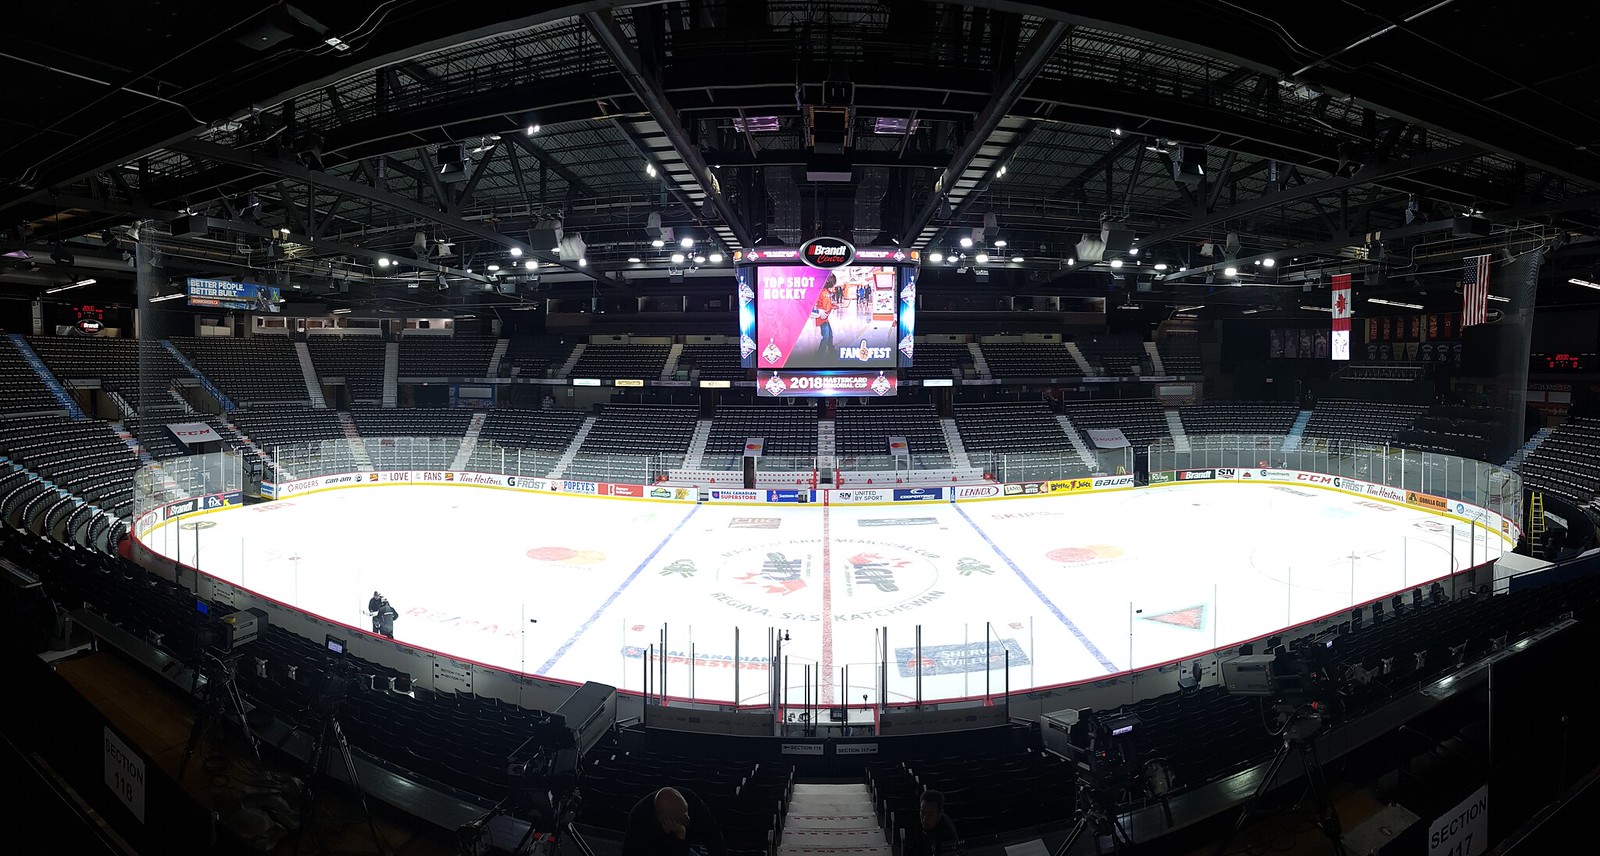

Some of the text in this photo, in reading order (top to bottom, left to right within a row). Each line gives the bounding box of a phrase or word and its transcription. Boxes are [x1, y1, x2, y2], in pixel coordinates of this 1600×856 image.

[814, 245, 847, 256] Brandt
[190, 279, 245, 291] BETTER PEOPLE.
[763, 277, 815, 288] TOP SHOT
[190, 287, 217, 296] BETTER
[763, 289, 806, 300] HOCKEY
[790, 377, 823, 389] 2018
[390, 472, 409, 481] LOVE
[424, 472, 442, 480] FANS
[459, 473, 502, 486] Tim Hortons
[1185, 471, 1212, 479] Brandt
[1297, 473, 1332, 484] CCM
[294, 480, 319, 491] ROGERS
[517, 481, 546, 490] FROST
[1341, 482, 1364, 492] FROST
[1367, 484, 1378, 496] Tim
[960, 487, 992, 496] LENNOX
[1420, 496, 1446, 508] GORILLA GLUE
[170, 501, 193, 515] Brandt
[105, 738, 143, 786] SECTION
[114, 771, 133, 803] 118
[1431, 796, 1487, 850] SECTION
